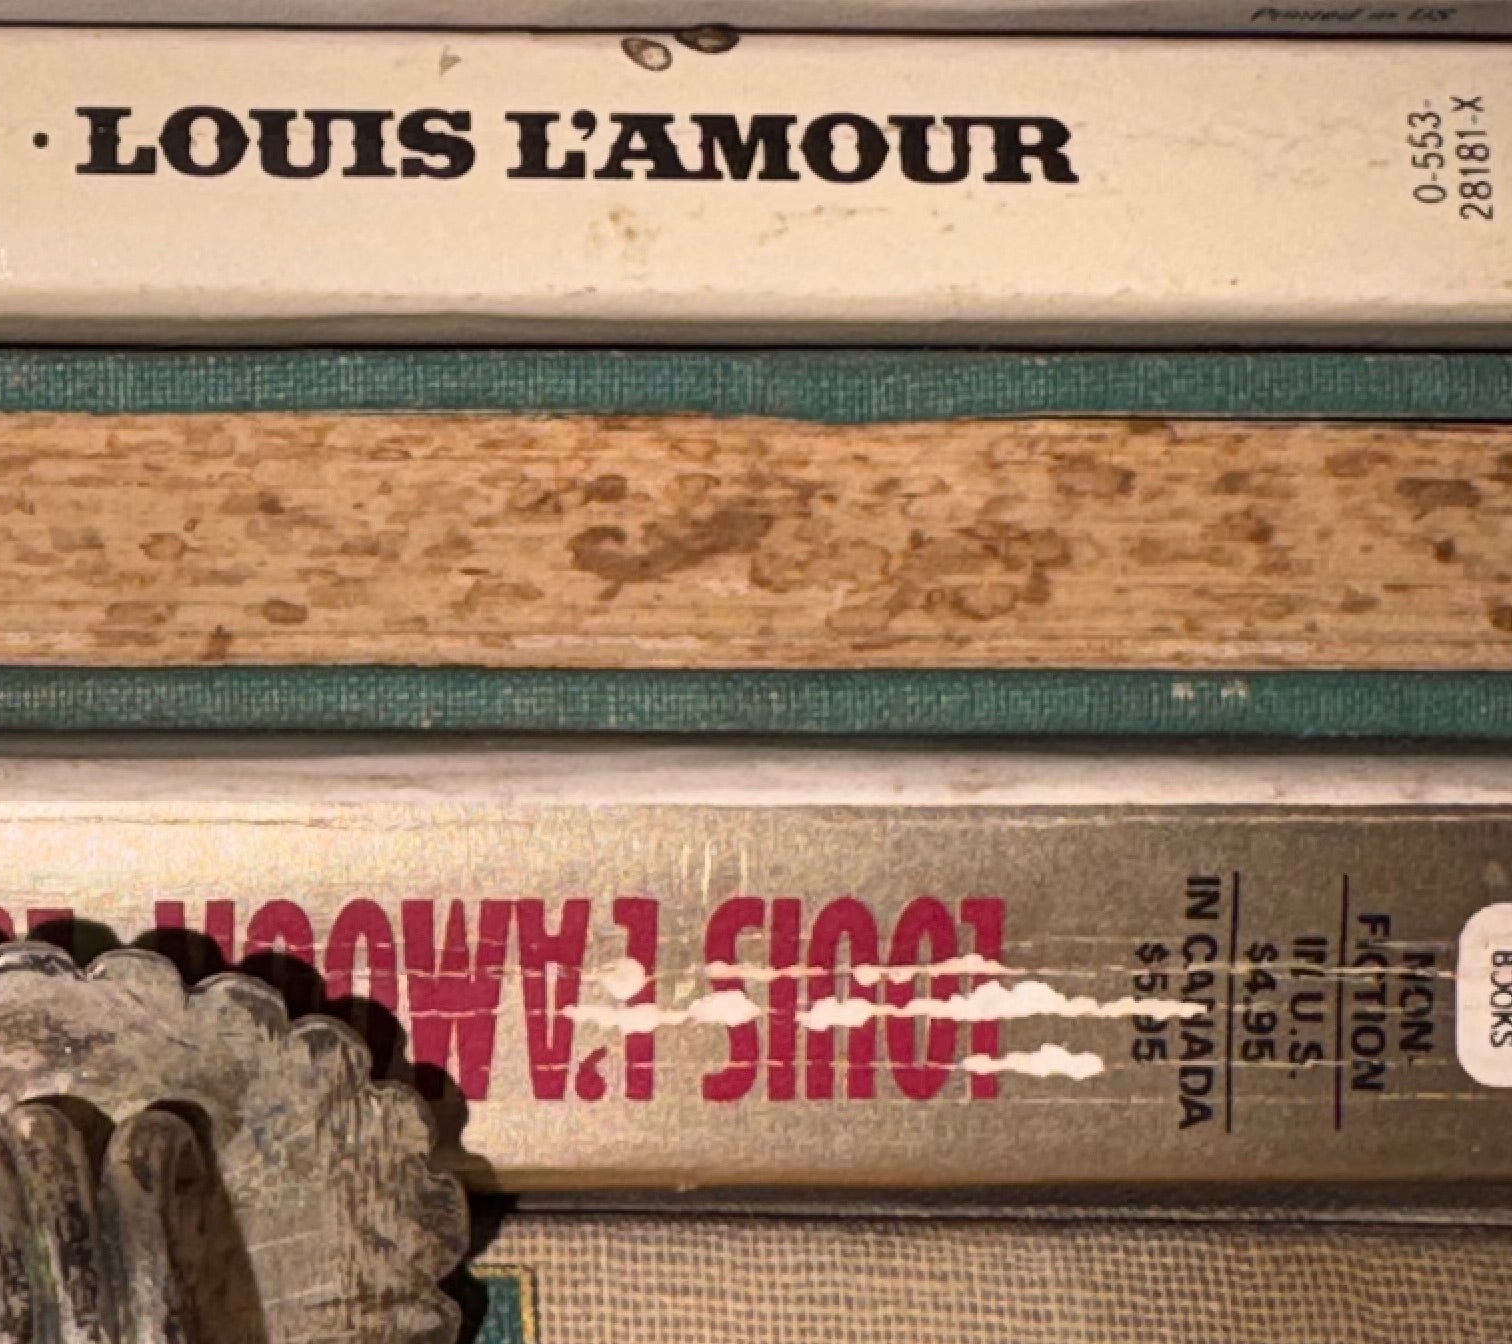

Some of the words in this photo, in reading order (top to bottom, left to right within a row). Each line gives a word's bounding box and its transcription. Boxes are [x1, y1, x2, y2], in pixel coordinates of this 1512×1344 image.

[75, 107, 475, 179] LOUIS
[506, 109, 1079, 184] L'AMOUR
[1405, 99, 1447, 204] 0-553-
[1449, 96, 1493, 221] 28181-X
[1185, 875, 1222, 921] IN
[702, 895, 1005, 1103] LOUIS
[1242, 942, 1278, 1064] $4.95
[1290, 936, 1328, 978] IN
[1351, 913, 1391, 1093] FICTION
[1399, 951, 1435, 1066] NON-
[1178, 934, 1218, 1130] CANADA
[1288, 990, 1326, 1080] U.S.
